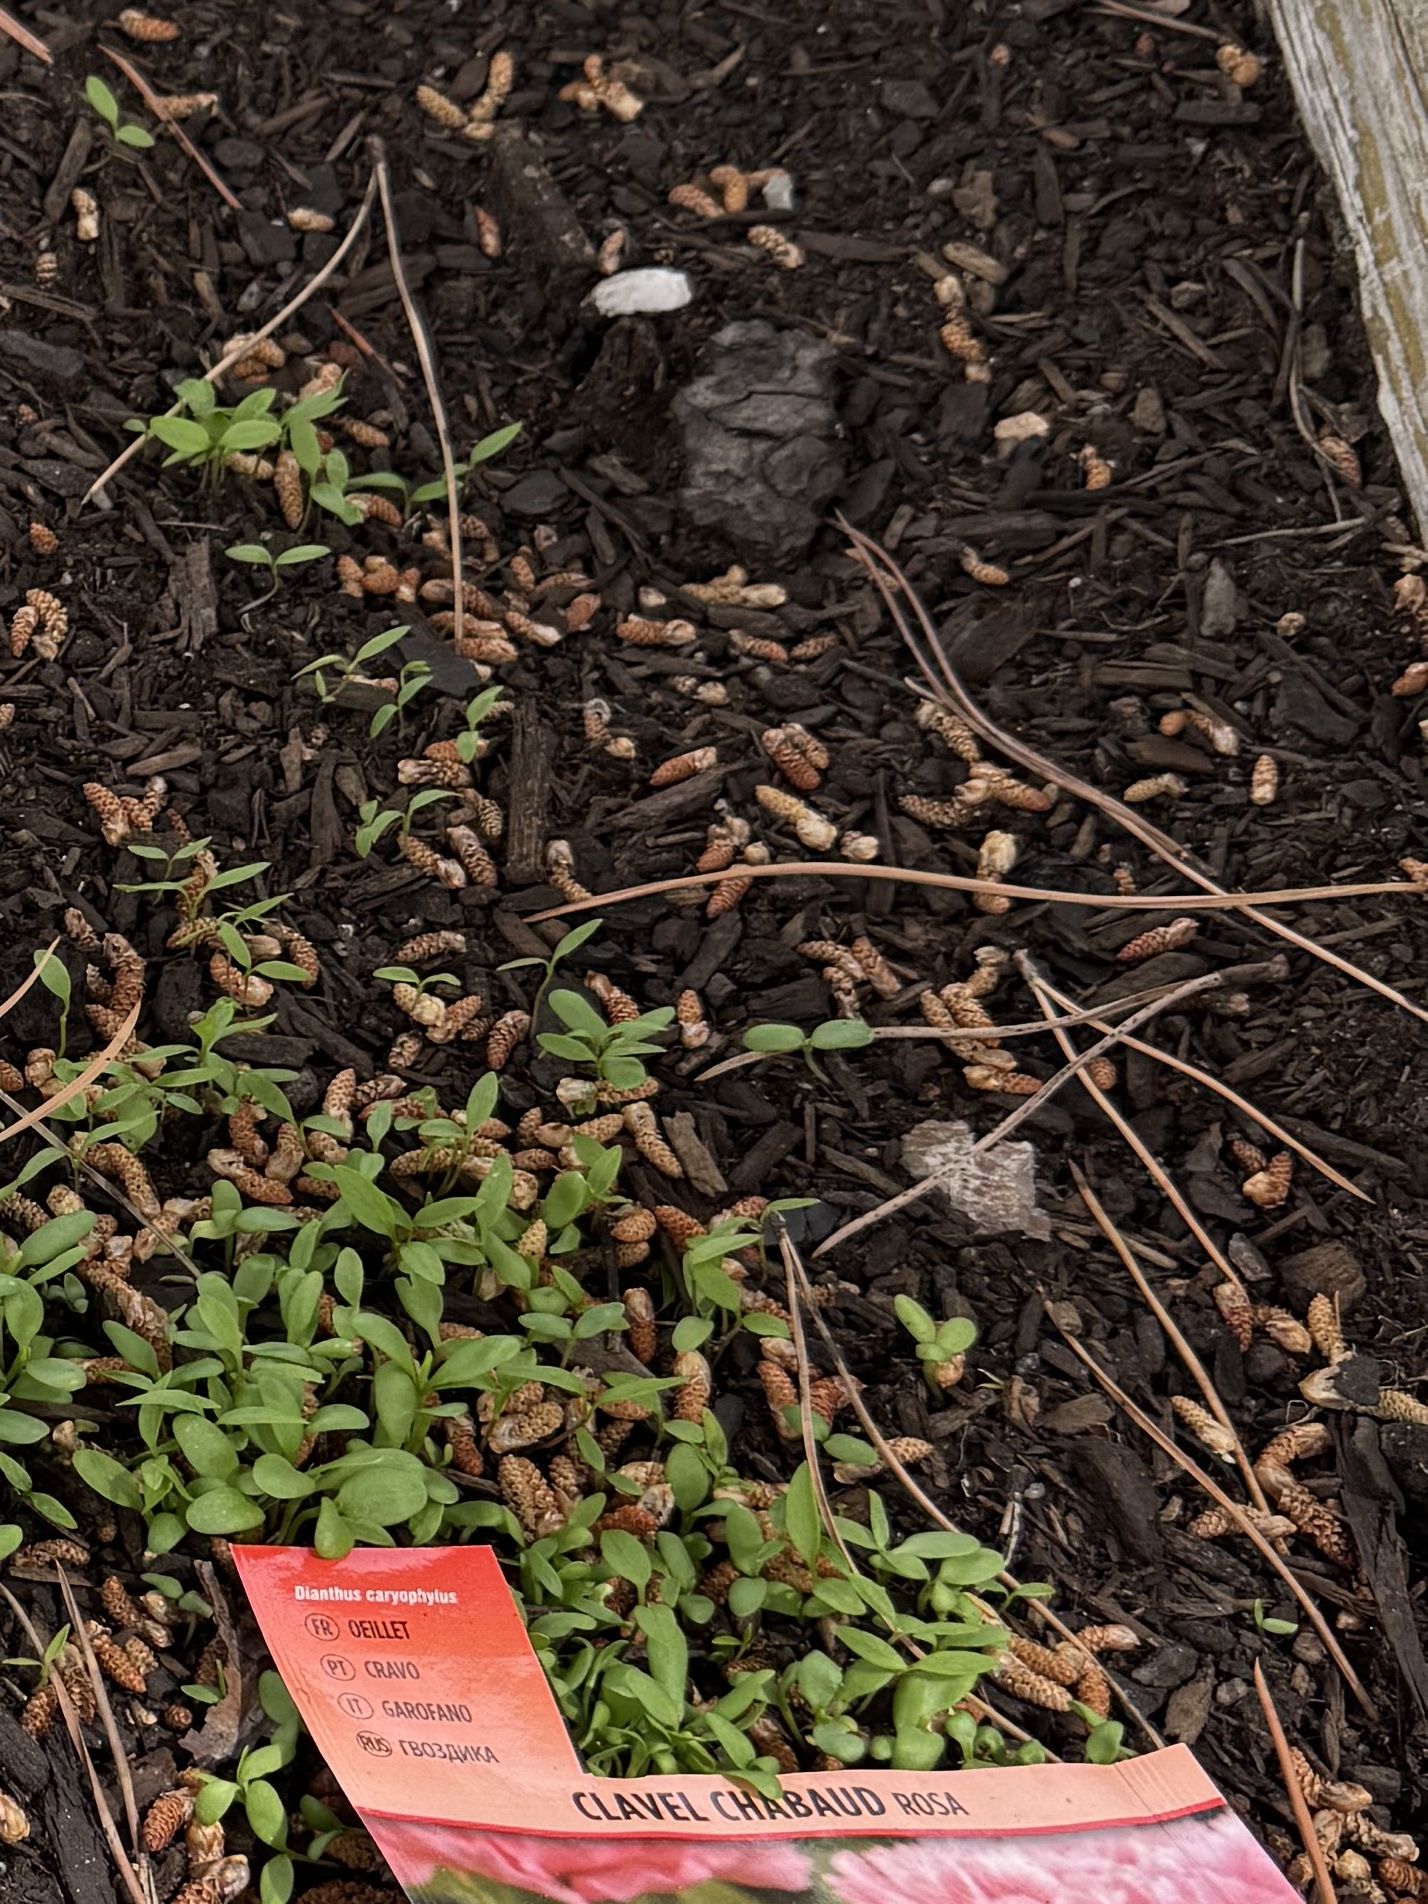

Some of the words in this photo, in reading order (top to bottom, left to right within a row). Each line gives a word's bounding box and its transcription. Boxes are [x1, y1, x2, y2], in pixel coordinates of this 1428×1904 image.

[294, 1585, 361, 1603] Dianthus
[365, 1588, 457, 1606] caryophylus
[312, 1617, 334, 1635] FR
[348, 1620, 411, 1640] OEILLET
[326, 1659, 349, 1676] PT
[363, 1660, 421, 1680] CRAVO
[382, 1700, 473, 1723] GAROFANO
[359, 1733, 390, 1753] RUS
[398, 1739, 500, 1764] ГВОЗДИКА
[572, 1791, 711, 1823] CLAVEL
[710, 1786, 886, 1822] CHABAUD
[890, 1791, 970, 1817] ROSA
